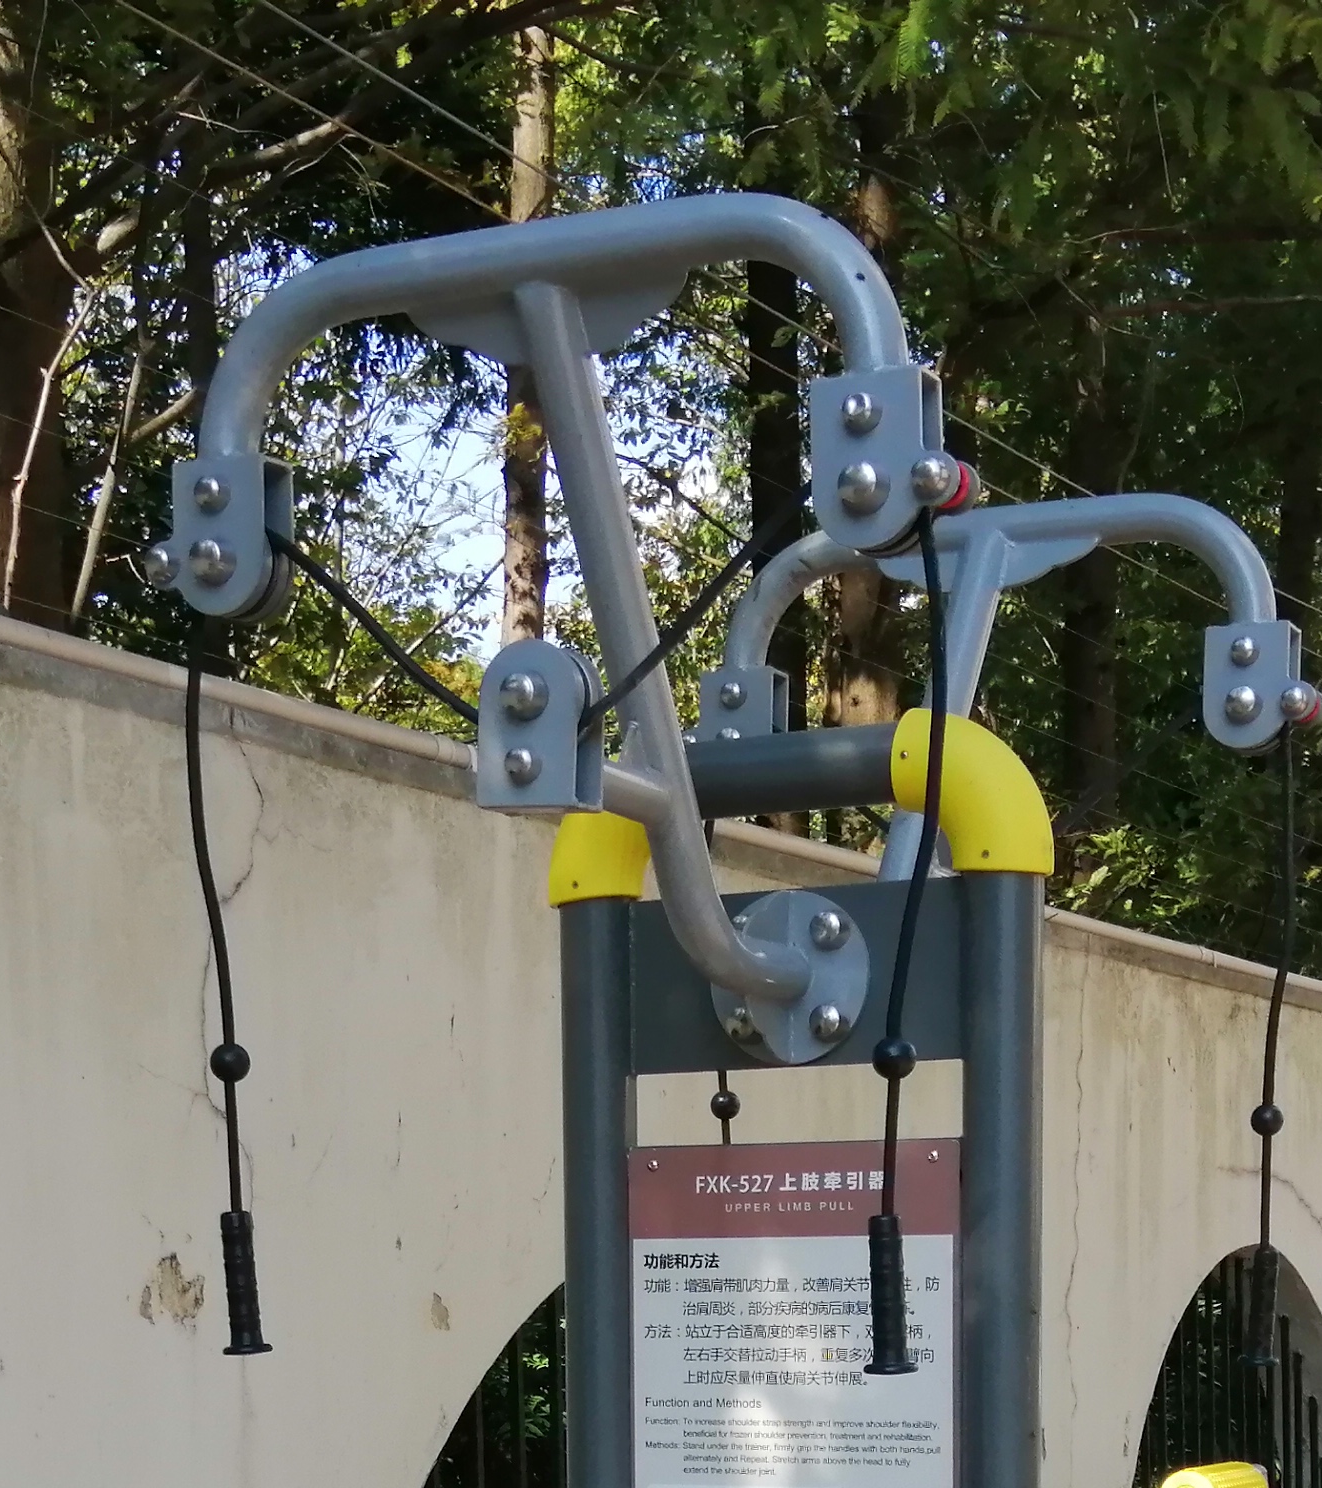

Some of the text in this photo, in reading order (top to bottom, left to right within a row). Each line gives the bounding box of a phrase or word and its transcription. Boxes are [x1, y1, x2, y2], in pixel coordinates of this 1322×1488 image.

[696, 1170, 884, 1194] FXK-527 上肢牵引器
[725, 1201, 854, 1213] UPPER LIMB PULL
[644, 1253, 720, 1270] 功能和方法
[645, 1397, 761, 1409] Function and Methods
[695, 1418, 725, 1426] increase
[728, 1418, 760, 1426] shoulder
[783, 1420, 814, 1428] strength
[833, 1421, 863, 1429] improve
[683, 1430, 717, 1438] beneficial
[754, 1431, 786, 1439] shoulder
[682, 1442, 705, 1450] Stand
[706, 1442, 728, 1450] under
[828, 1445, 859, 1453] handles
[862, 1445, 877, 1453] with
[723, 1455, 738, 1463] and
[863, 1458, 883, 1466] head
[885, 1458, 893, 1466] to
[710, 1467, 723, 1475] the
[724, 1467, 757, 1475] shoulder
